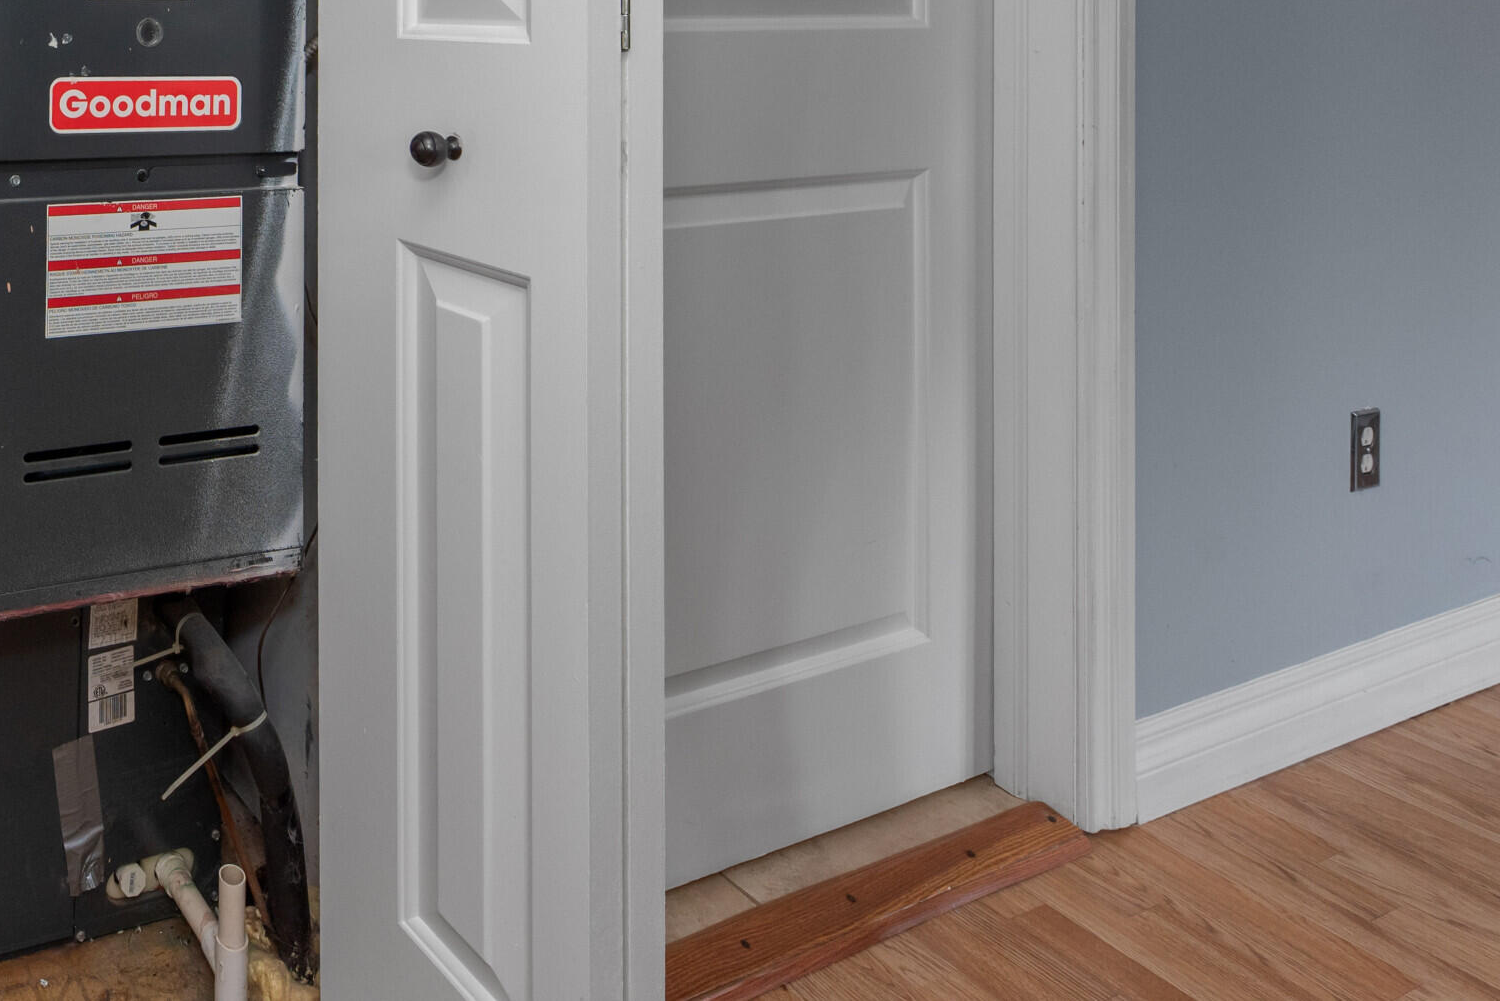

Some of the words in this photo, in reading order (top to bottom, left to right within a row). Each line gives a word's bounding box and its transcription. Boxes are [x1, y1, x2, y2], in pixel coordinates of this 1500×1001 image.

[59, 88, 231, 119] Goodman
[132, 202, 158, 210] DANGER
[132, 256, 158, 264] DANGER
